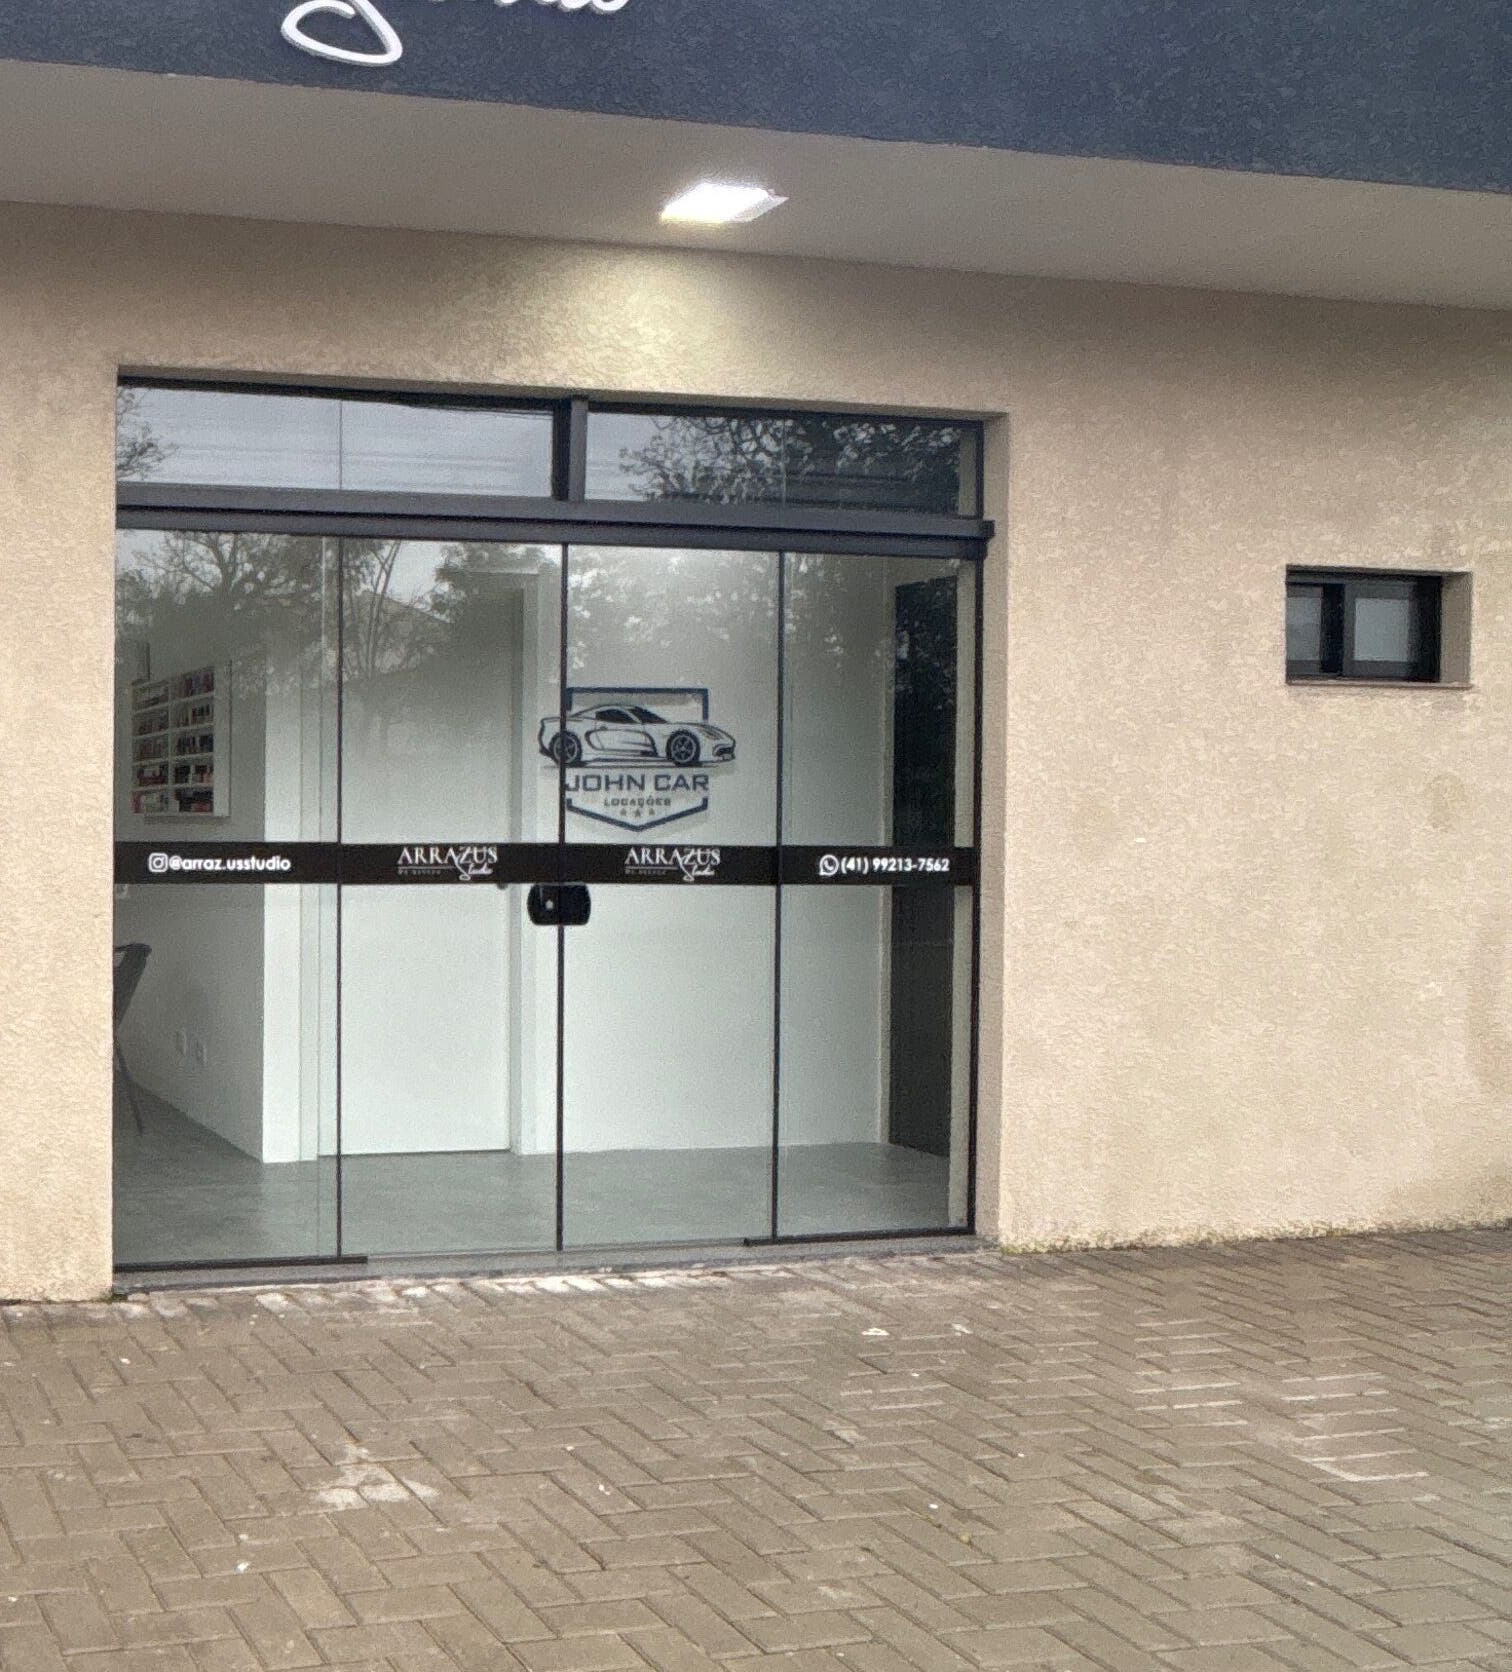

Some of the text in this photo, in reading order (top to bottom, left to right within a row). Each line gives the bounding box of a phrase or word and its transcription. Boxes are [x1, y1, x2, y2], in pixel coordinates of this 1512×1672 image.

[565, 774, 709, 792] JOHN CAR
[169, 855, 291, 871] @arraz.usstudio
[397, 846, 498, 864] ARRAZUS
[624, 846, 721, 866] ARRAZUS
[840, 856, 950, 875] (41) 99213-7562
